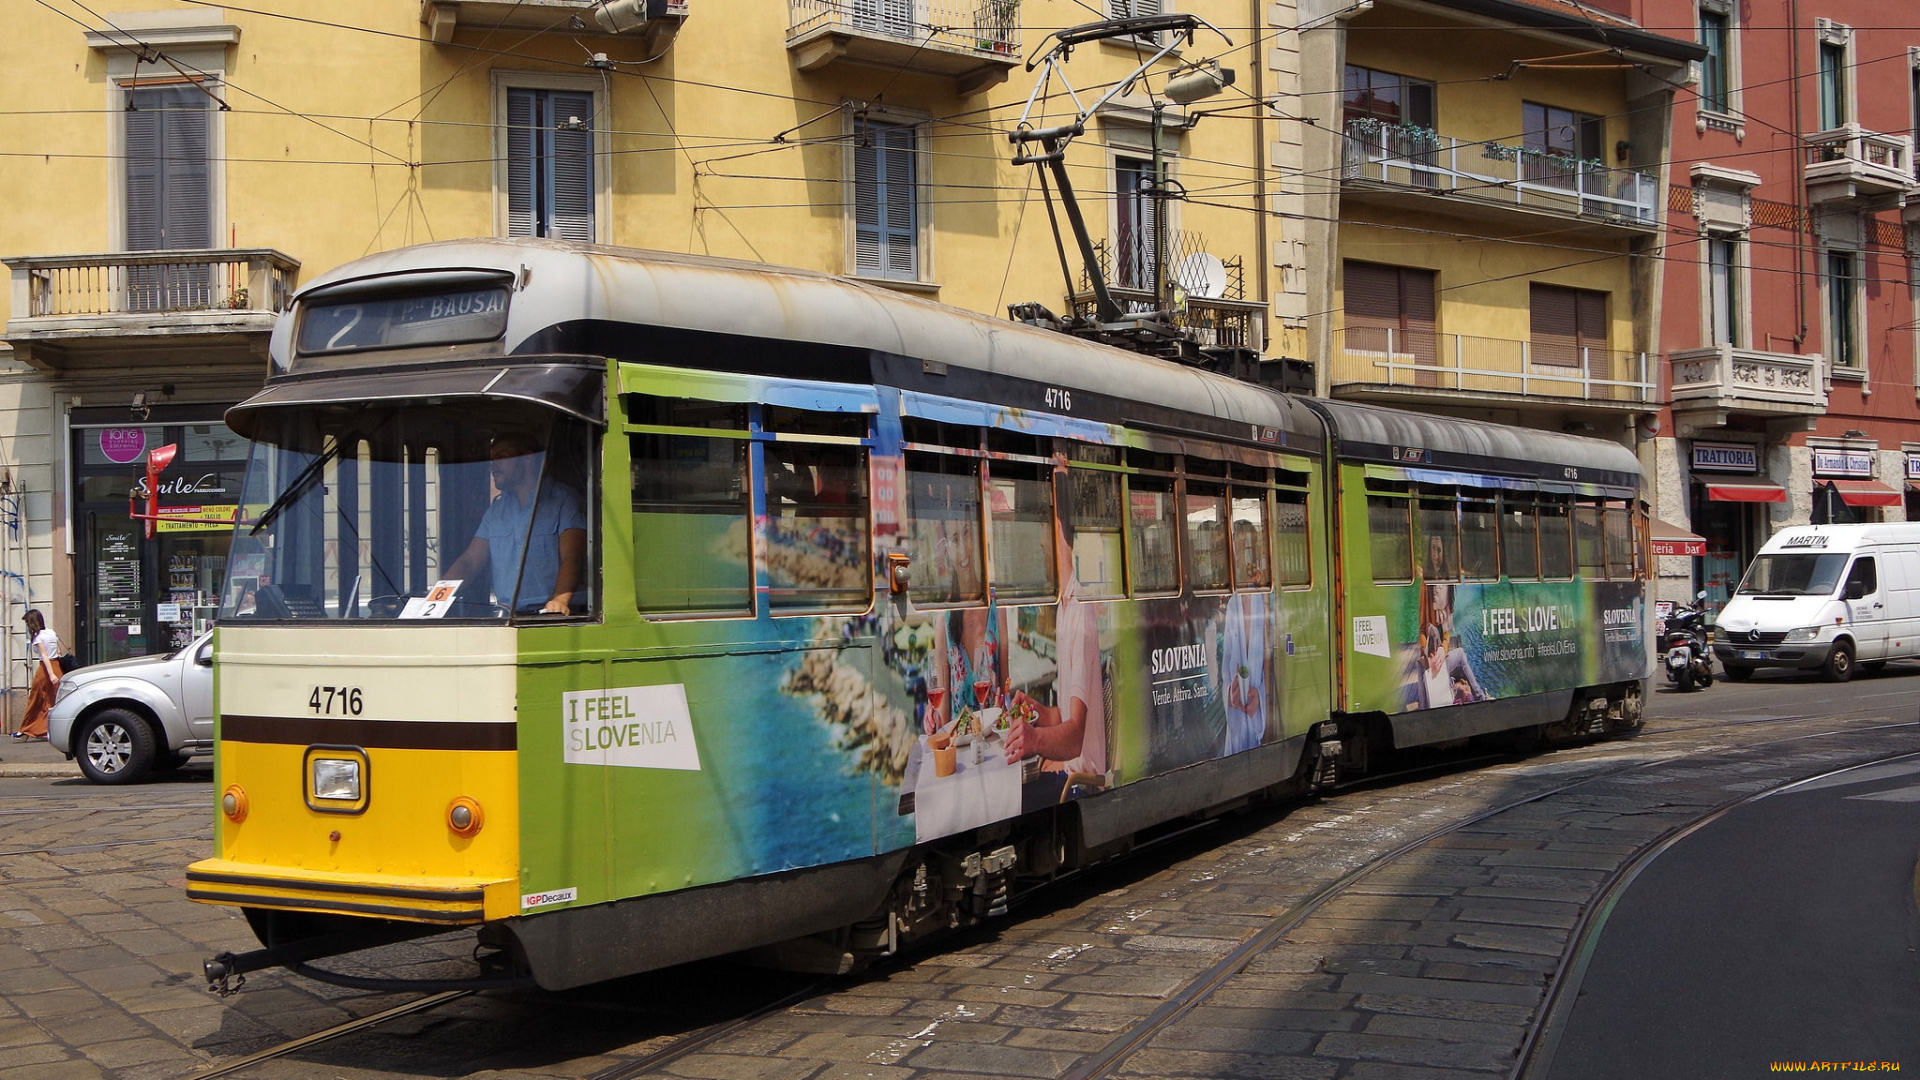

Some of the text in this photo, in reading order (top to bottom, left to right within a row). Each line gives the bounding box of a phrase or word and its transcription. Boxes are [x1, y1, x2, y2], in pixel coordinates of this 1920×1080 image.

[326, 304, 363, 350] 2
[1045, 388, 1071, 411] 4716
[1695, 449, 1755, 465] TRATTORIA
[1564, 467, 1578, 480] 4716
[1685, 542, 1699, 554] bar
[1786, 535, 1829, 545] MARTIN
[435, 587, 447, 601] 6
[423, 603, 436, 616] 2
[1603, 609, 1637, 624] SLOVENIA
[1359, 621, 1373, 631] FEEL
[1482, 605, 1576, 635] I FEEL SLOVENIA
[1152, 643, 1208, 675] SLOVENIA
[309, 686, 362, 715] 4716
[1152, 687, 1172, 706] Verde.
[569, 695, 636, 722] I FEEL
[570, 720, 677, 752] SLOVENIA
[526, 892, 572, 905] IGPDecaux
